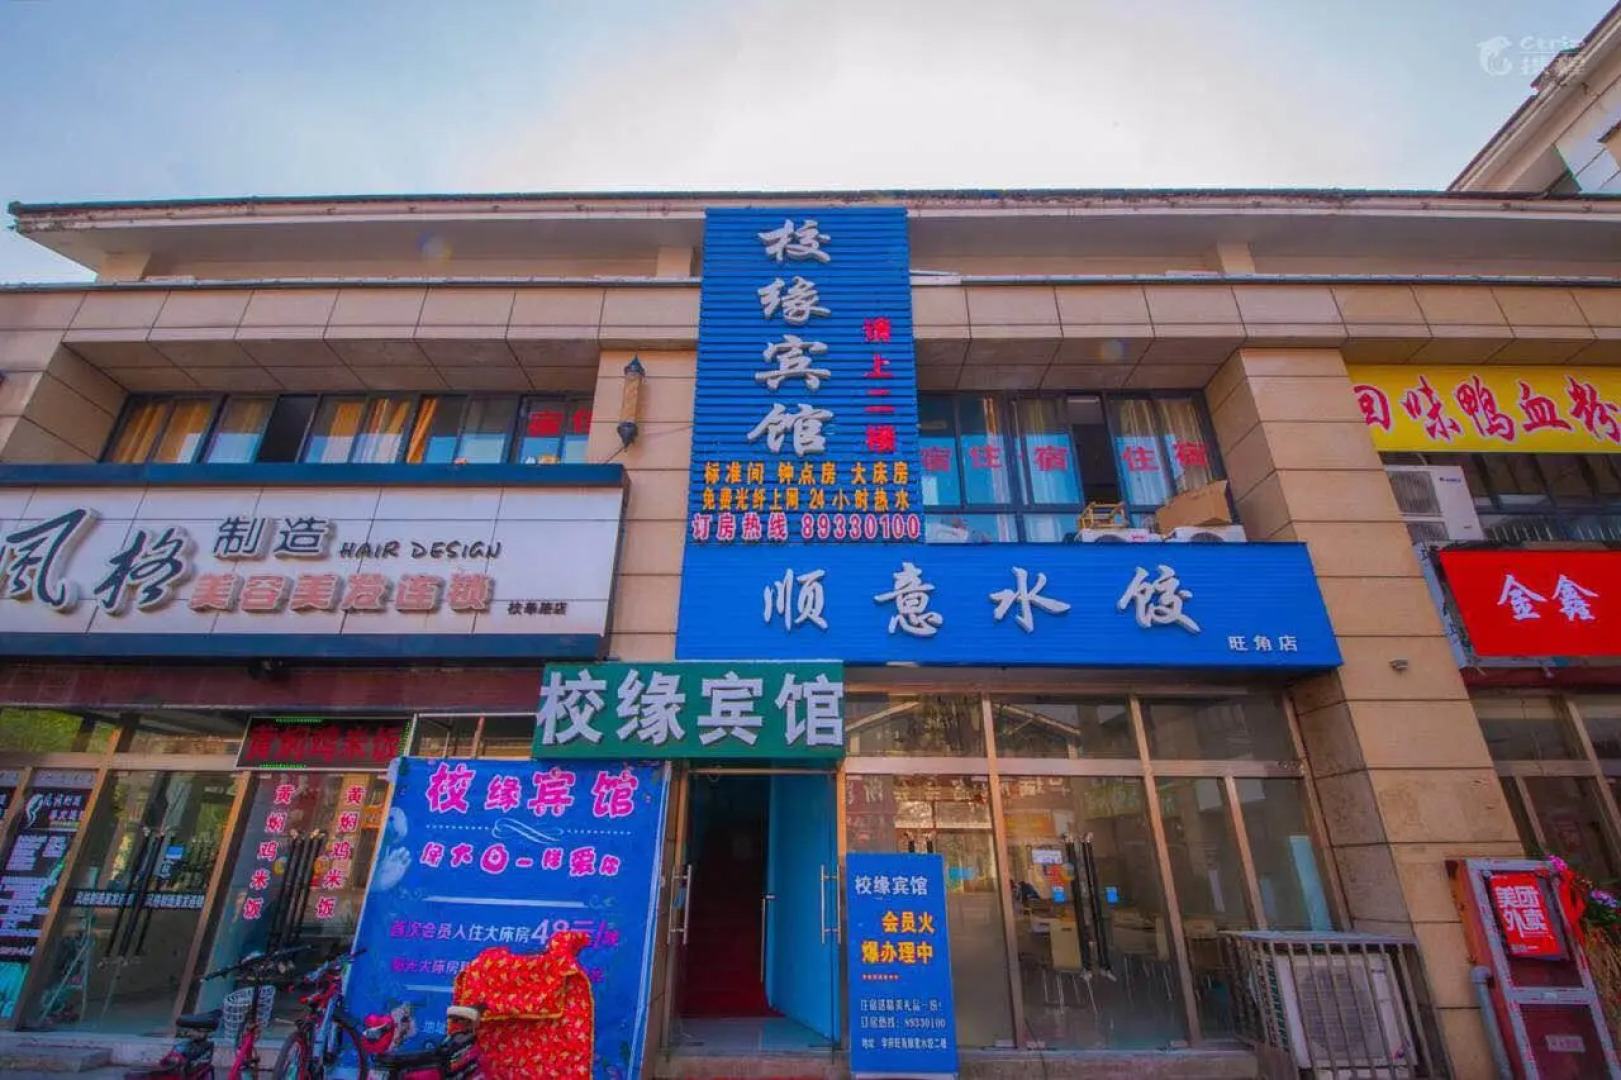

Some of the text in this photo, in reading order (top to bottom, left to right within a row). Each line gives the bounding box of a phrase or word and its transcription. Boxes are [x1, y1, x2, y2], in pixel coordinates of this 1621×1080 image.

[747, 219, 833, 457] 校缘宾馆
[704, 461, 908, 484] 标准间 钟点房 大床房
[702, 487, 799, 510] 免费光纤上网
[214, 516, 330, 557] 制造
[340, 541, 400, 559] HAIR
[411, 541, 502, 560] DESIGN
[692, 512, 920, 541] 订房热线 89330100
[191, 573, 492, 612] 美容美发连锁
[763, 562, 1201, 639] 顺意水饺
[1497, 574, 1599, 621] 金鑫
[1228, 634, 1298, 653] 旺角店
[537, 668, 843, 746] 校缘宾馆
[426, 762, 639, 818] 校缘宾馆
[243, 784, 296, 919] 黄焖鸡米饭
[316, 785, 366, 918] 黄焖鸡米饭
[855, 875, 928, 895] 校缘宾馆
[1495, 886, 1540, 908] 美团
[882, 911, 935, 933] 会员火
[1503, 907, 1549, 938] 外卖
[861, 941, 934, 964] 爆办理中
